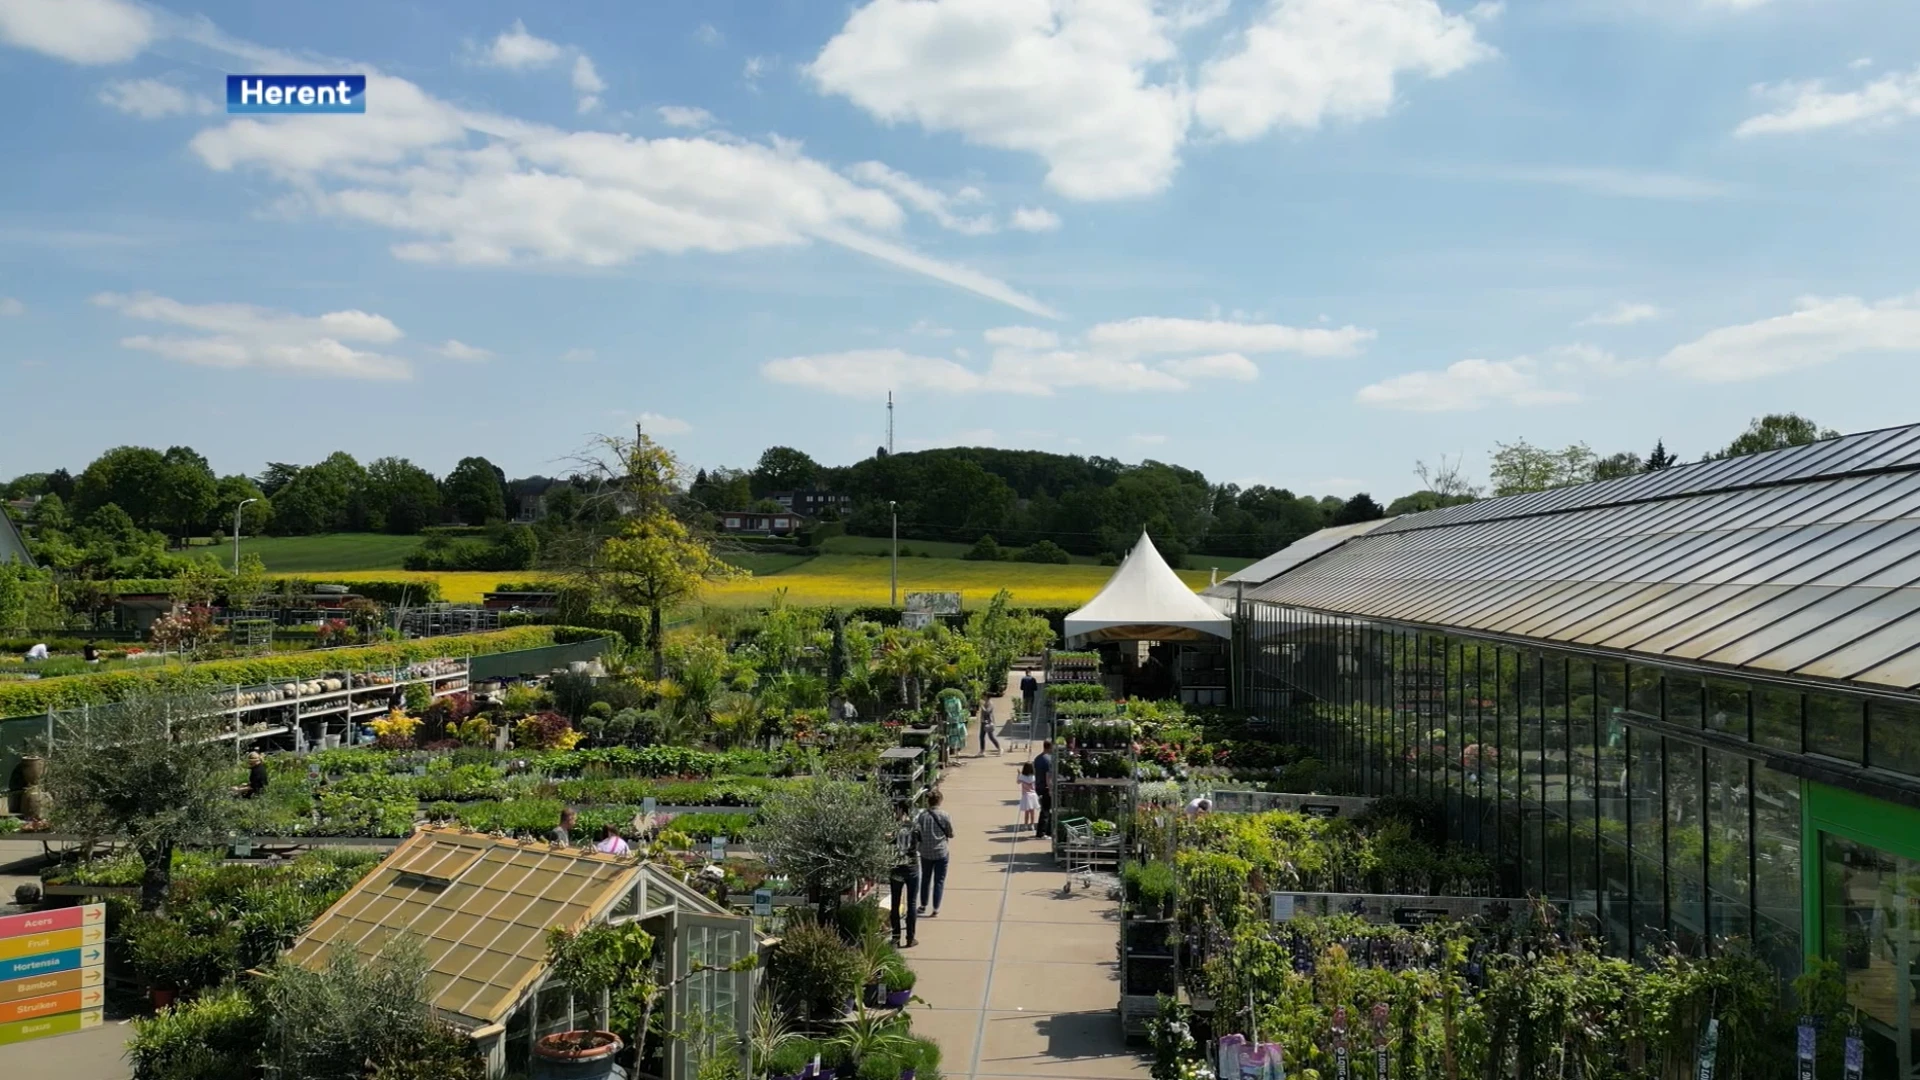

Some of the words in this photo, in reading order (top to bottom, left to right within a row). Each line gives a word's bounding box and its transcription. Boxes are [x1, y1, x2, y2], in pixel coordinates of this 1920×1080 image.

[24, 918, 53, 928] Acers
[27, 938, 50, 948] Fruit
[13, 958, 61, 971] Hortensia
[16, 1001, 57, 1014] Struiken
[21, 1022, 52, 1034] Buxus
